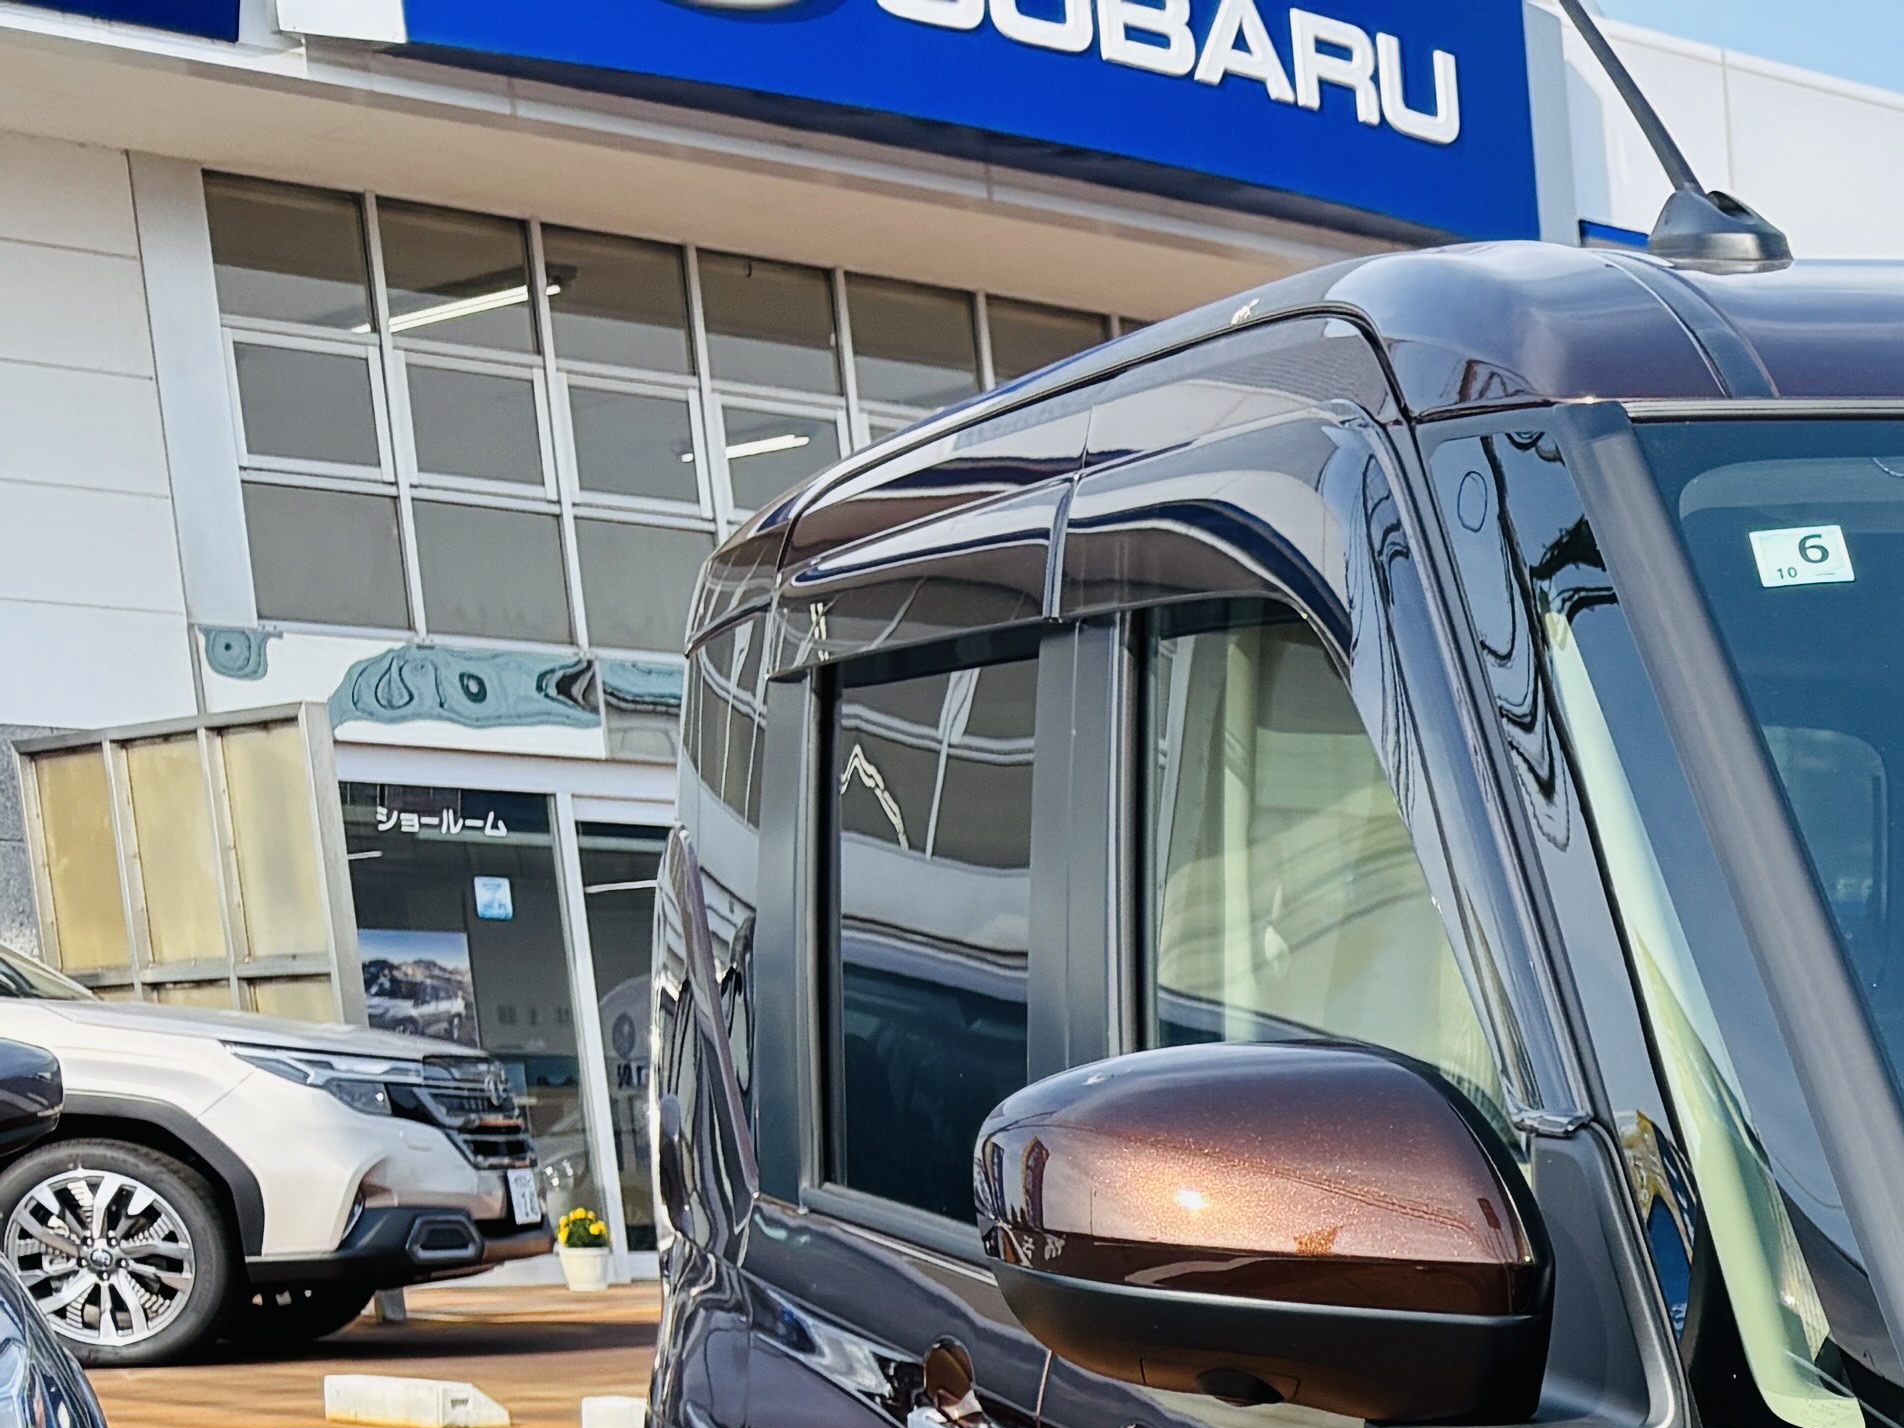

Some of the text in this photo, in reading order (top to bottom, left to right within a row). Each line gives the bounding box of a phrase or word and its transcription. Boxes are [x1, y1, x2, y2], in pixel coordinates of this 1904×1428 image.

[1798, 533, 1830, 564] 6
[1776, 566, 1798, 580] 10
[376, 805, 508, 837] ショールーム
